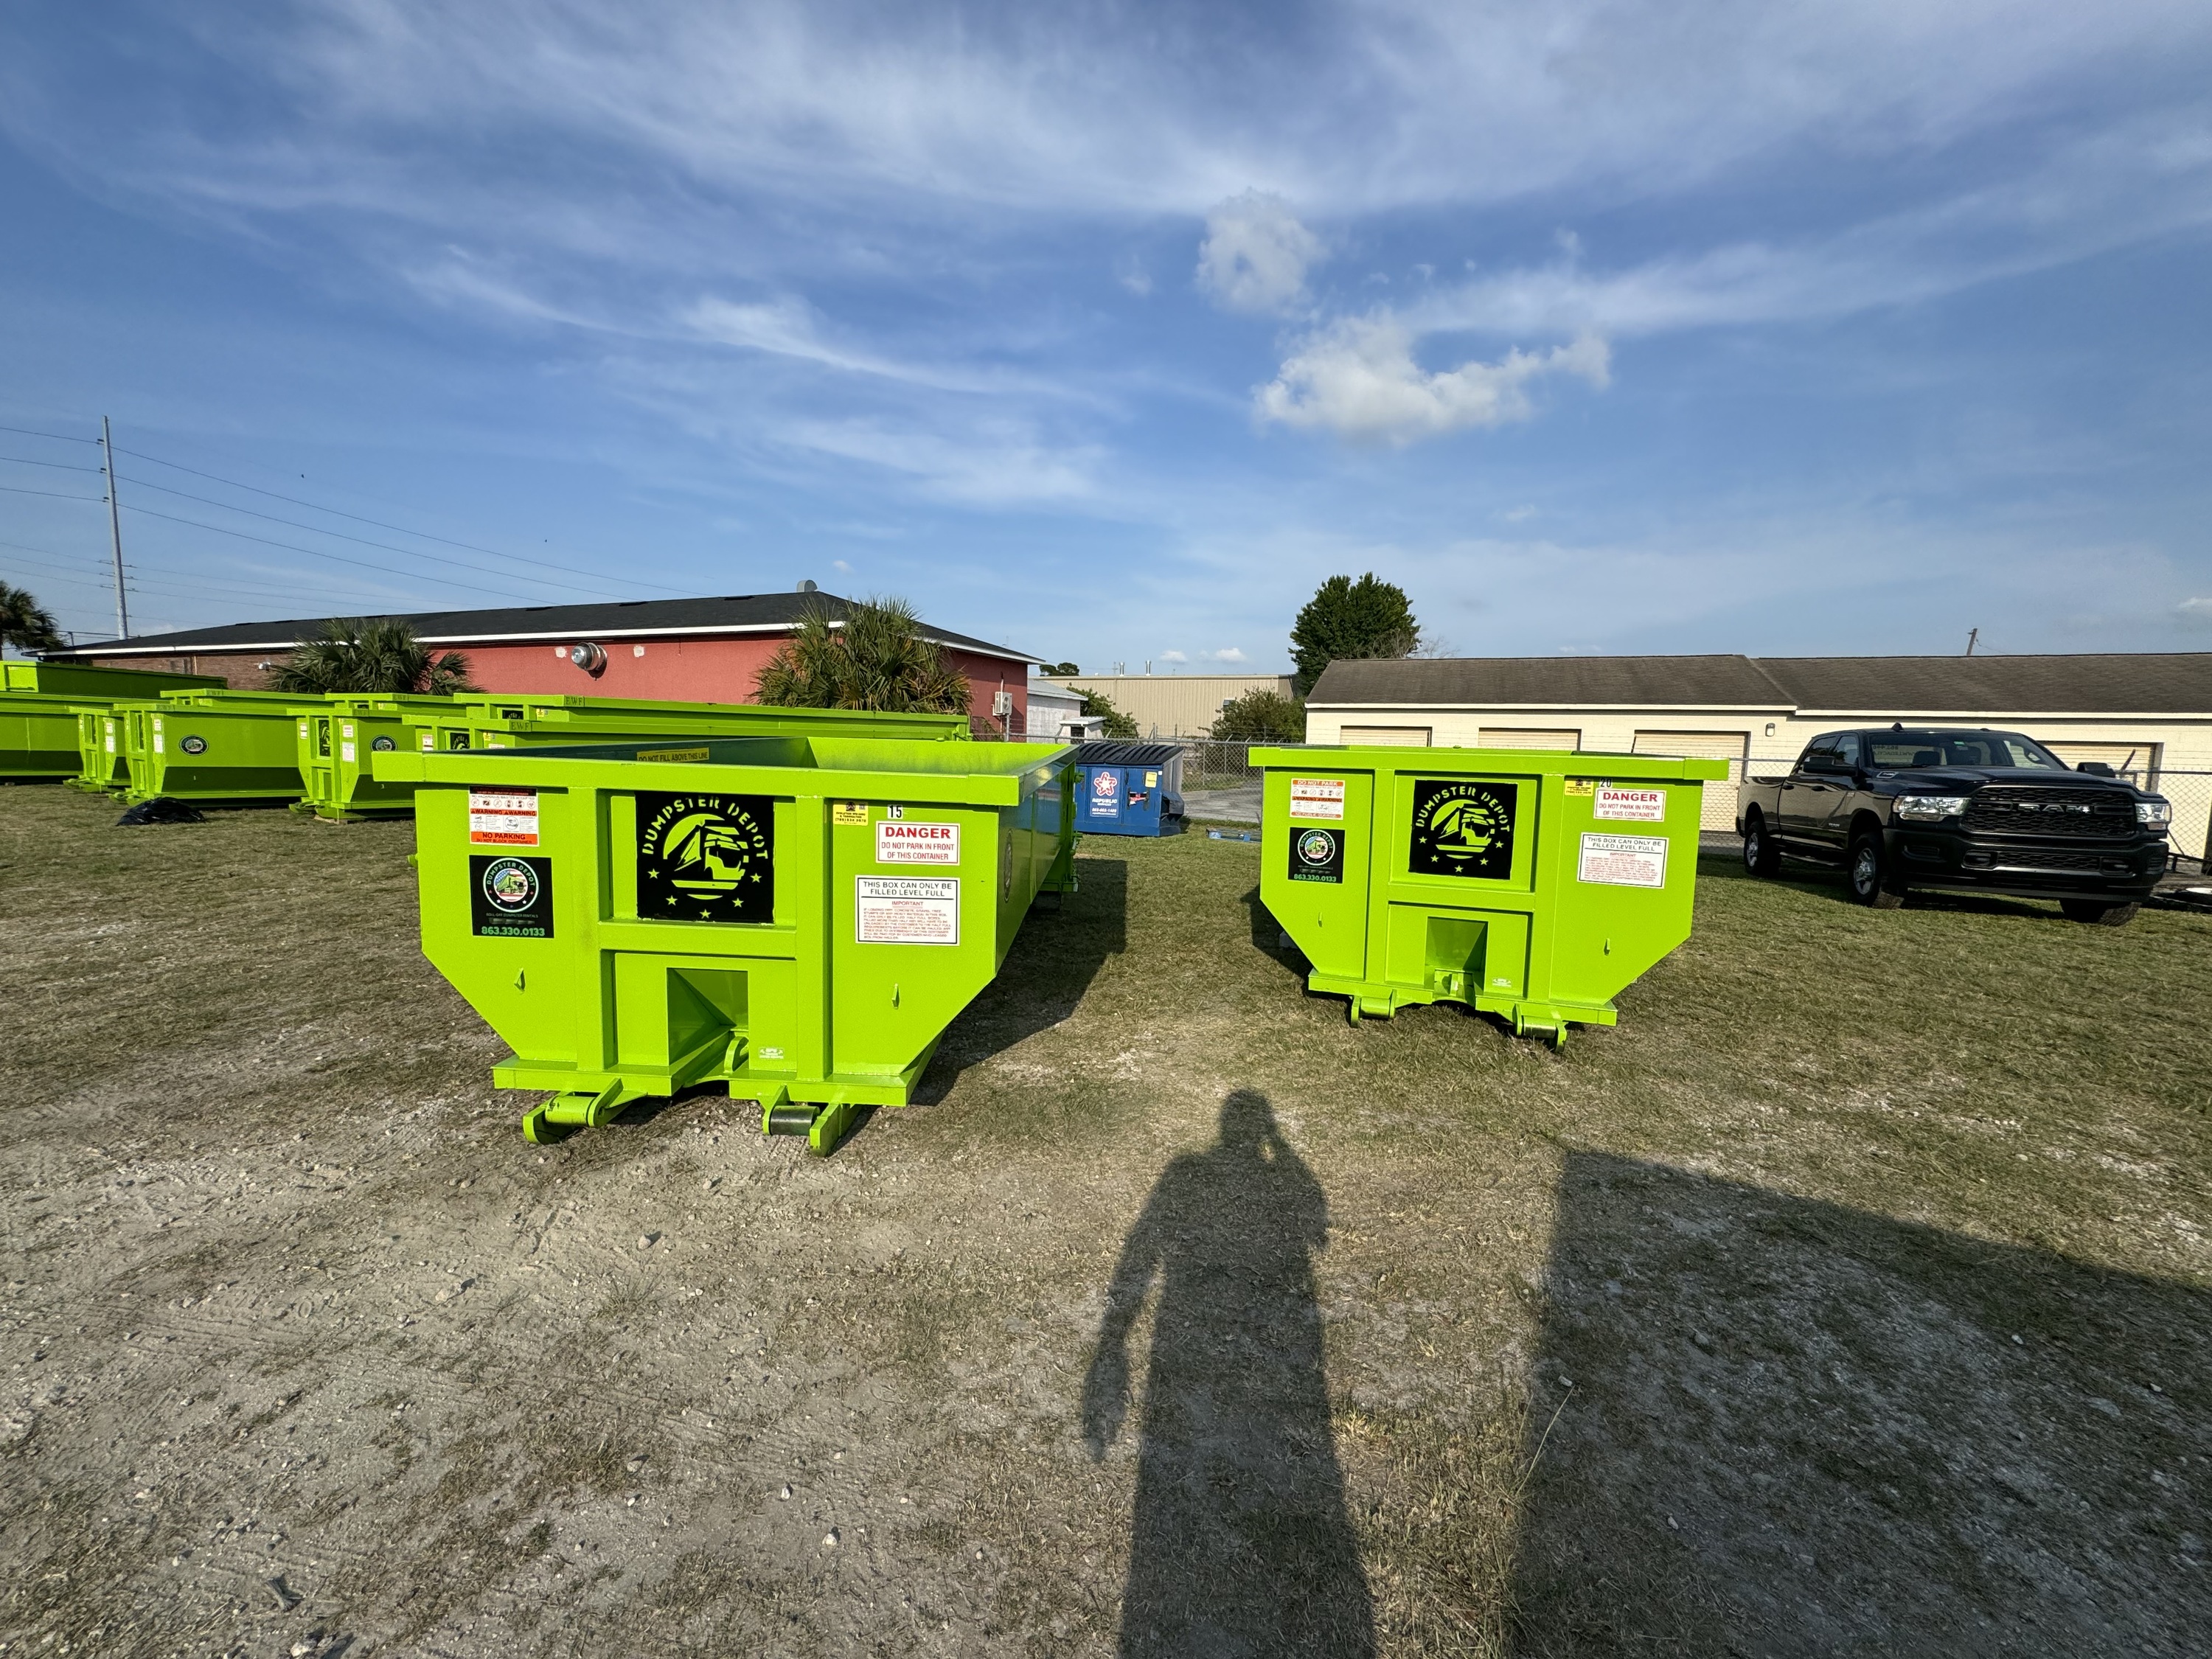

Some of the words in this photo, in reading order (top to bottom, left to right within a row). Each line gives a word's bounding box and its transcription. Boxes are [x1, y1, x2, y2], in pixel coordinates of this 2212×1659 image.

[565, 697, 582, 706] EWF
[510, 721, 529, 730] EWF
[1600, 778, 1611, 787] 20
[1603, 792, 1658, 802] DANGER
[888, 805, 902, 818] 15
[1416, 786, 1476, 827] DUMPSTER
[1481, 792, 1510, 832] DEPOT
[642, 796, 720, 855] DUMPSTER
[727, 802, 768, 859] DEPOT
[886, 827, 951, 839] DANGER
[1300, 832, 1321, 847] DUMPSTER
[1322, 835, 1333, 849] DEPOT
[487, 862, 516, 885] DUMPSTER
[518, 865, 535, 886] DEPOT
[1294, 874, 1337, 882] 863.330.0133
[481, 926, 545, 936] 863.330.0133
